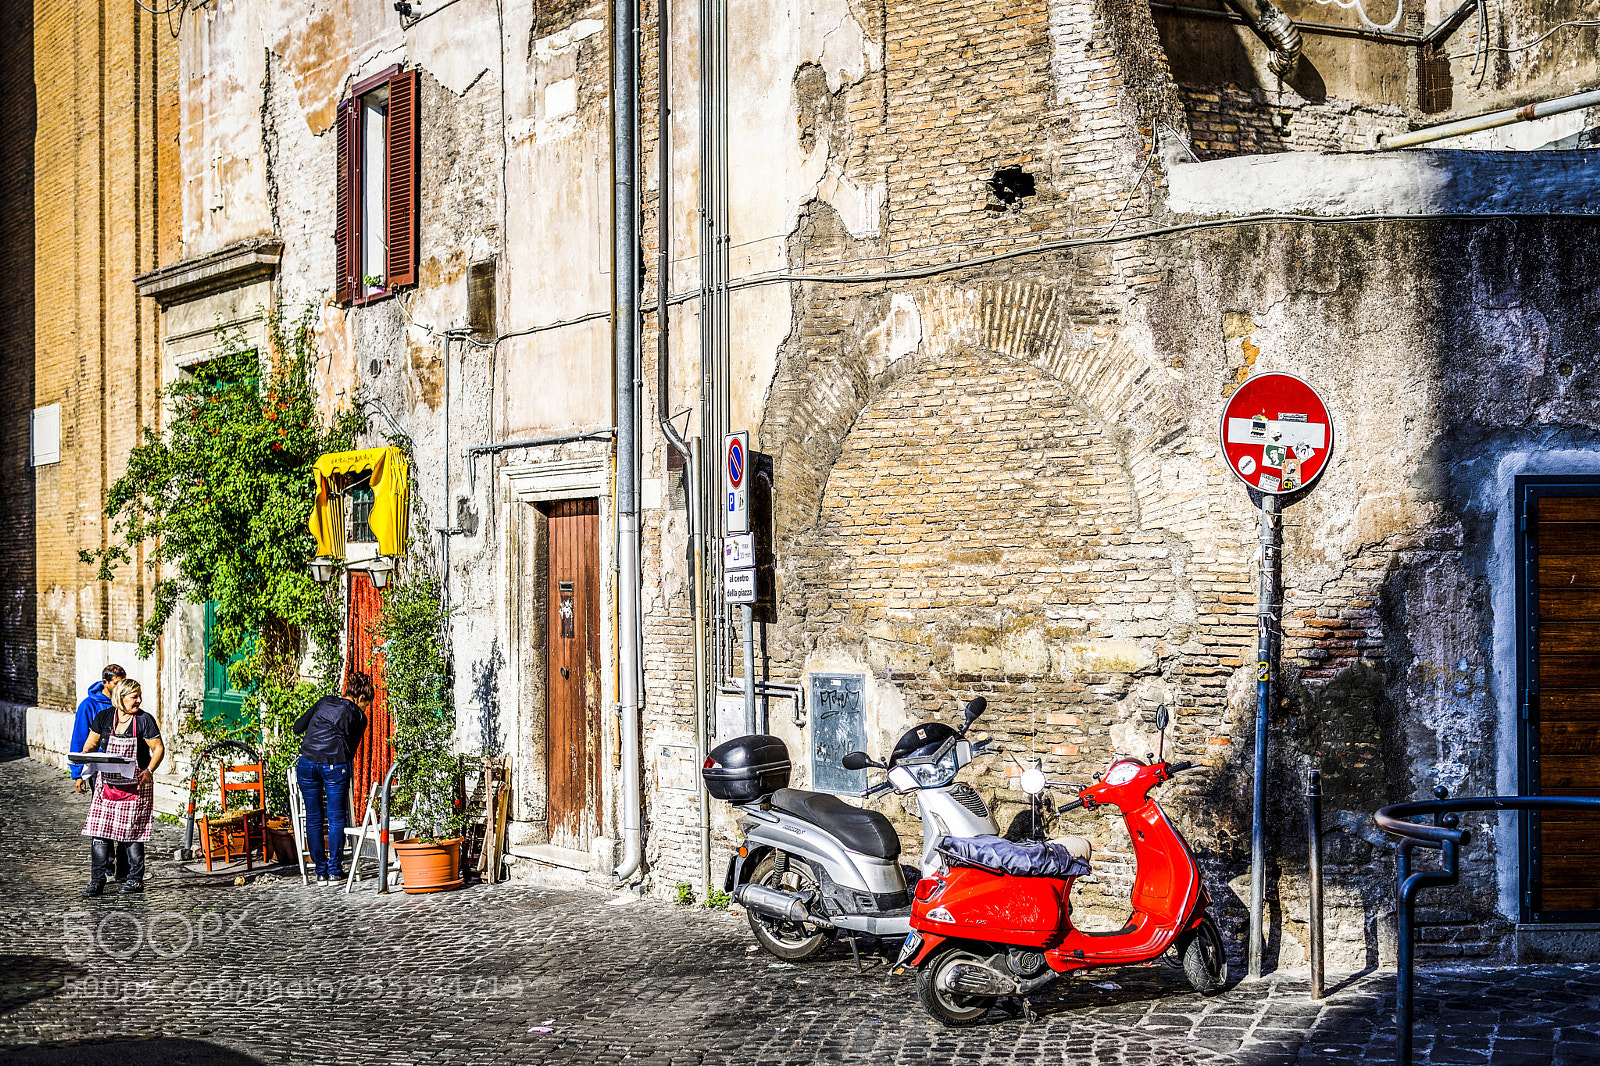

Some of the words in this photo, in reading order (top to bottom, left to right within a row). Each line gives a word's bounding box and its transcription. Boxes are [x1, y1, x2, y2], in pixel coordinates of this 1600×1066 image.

[730, 494, 734, 510] P
[734, 573, 750, 583] centro
[726, 588, 738, 598] della
[738, 588, 752, 598] piazza
